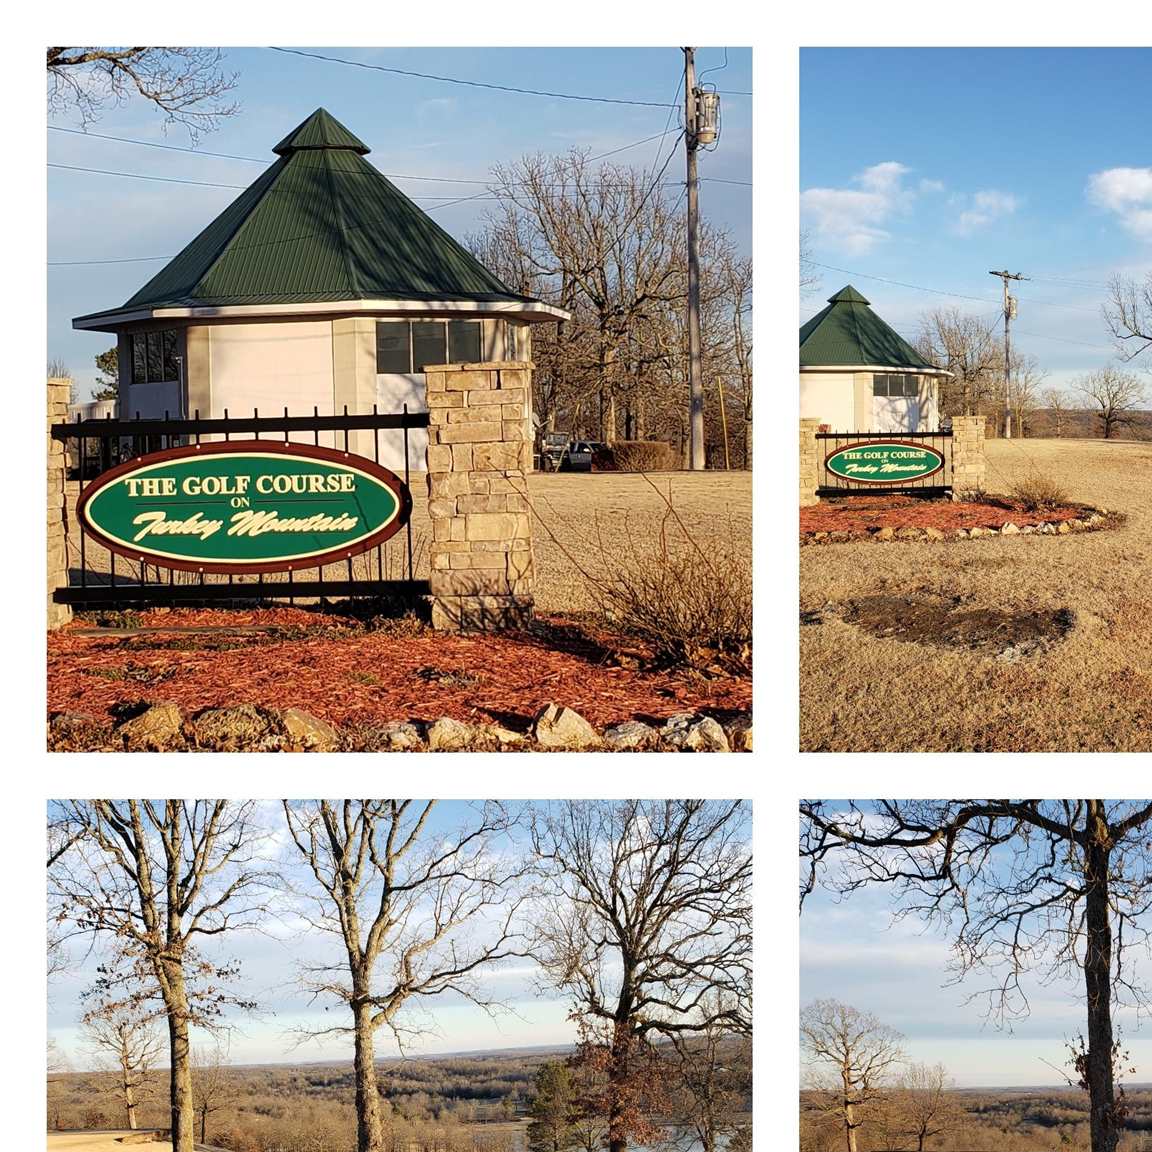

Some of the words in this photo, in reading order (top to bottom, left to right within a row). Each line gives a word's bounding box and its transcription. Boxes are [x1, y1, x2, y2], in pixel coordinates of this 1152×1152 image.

[843, 452, 862, 460] THE
[863, 451, 889, 459] GOLF
[890, 451, 927, 459] COURSE
[125, 477, 177, 497] THE
[182, 475, 251, 495] GOLF
[256, 473, 355, 494] COURSE
[230, 497, 250, 508] ON
[133, 512, 224, 542] Turkey
[227, 510, 358, 537] Mountain
